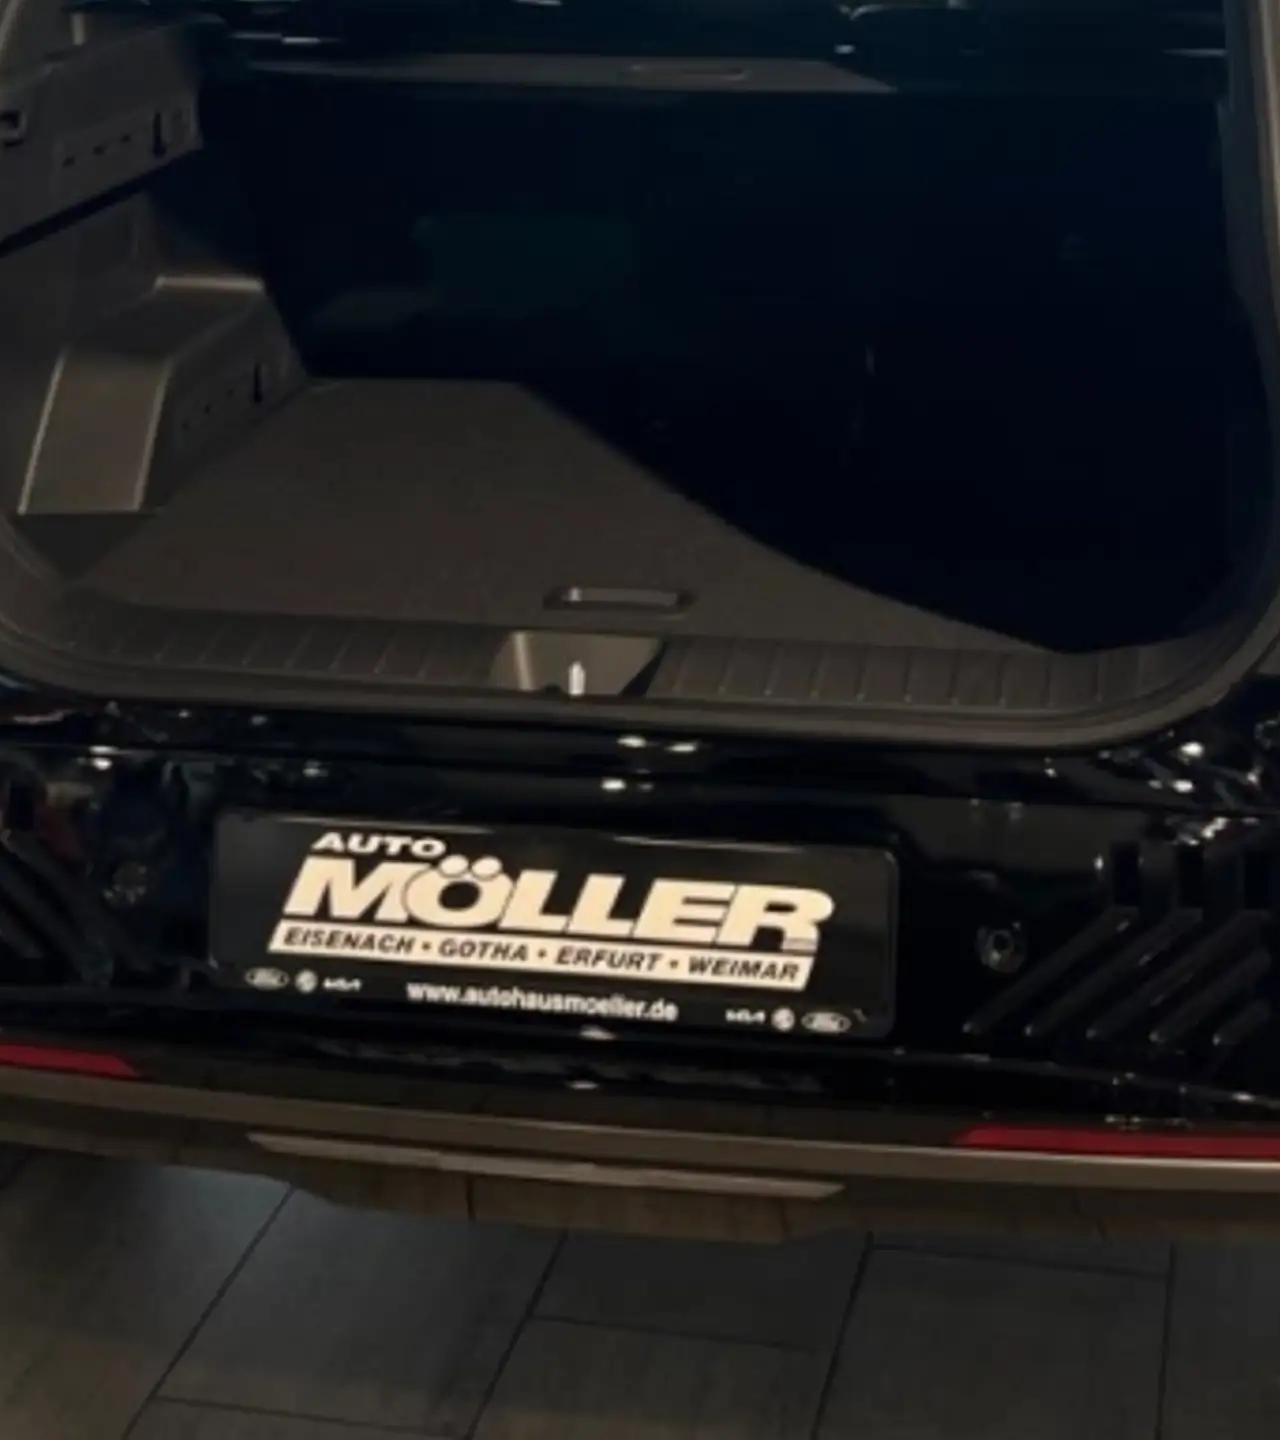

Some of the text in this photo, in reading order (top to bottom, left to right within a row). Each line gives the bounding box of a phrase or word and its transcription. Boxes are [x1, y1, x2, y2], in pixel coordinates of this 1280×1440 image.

[311, 831, 447, 859] AUTO
[282, 854, 836, 953] MÖLLER
[283, 926, 800, 983] EISENACH GOTHA ERFURT WEIMAR
[405, 981, 680, 1023] www.autohausmoeller.de
